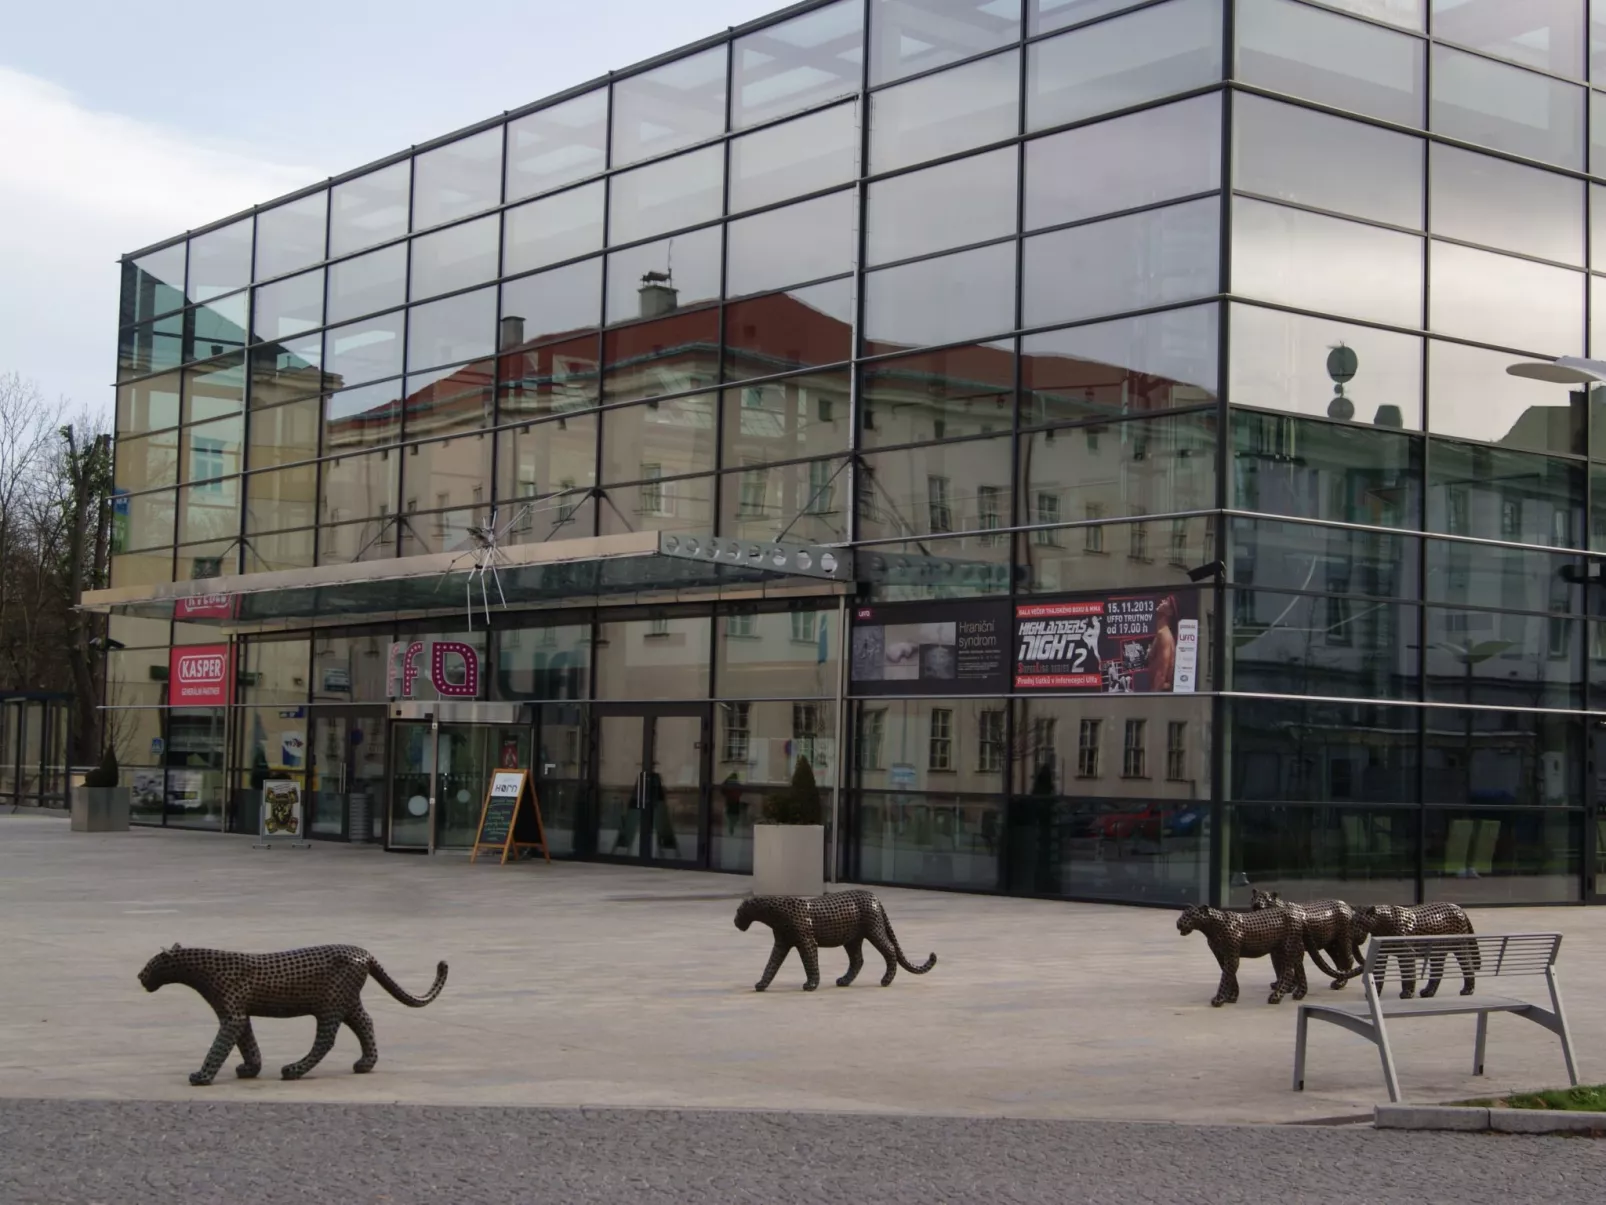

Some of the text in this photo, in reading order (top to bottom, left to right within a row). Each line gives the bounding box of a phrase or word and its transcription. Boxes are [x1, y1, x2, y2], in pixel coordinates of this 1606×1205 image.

[1108, 601, 1154, 613] 15. 11.2013
[959, 617, 995, 633] Hraniční
[1106, 614, 1153, 623] UFFO TRUTNOV
[1106, 622, 1148, 634] od 19.00 h
[959, 634, 996, 649] syndrom
[1018, 634, 1082, 660] NIGHT
[182, 659, 221, 677] KASPER
[1071, 648, 1088, 673] 2
